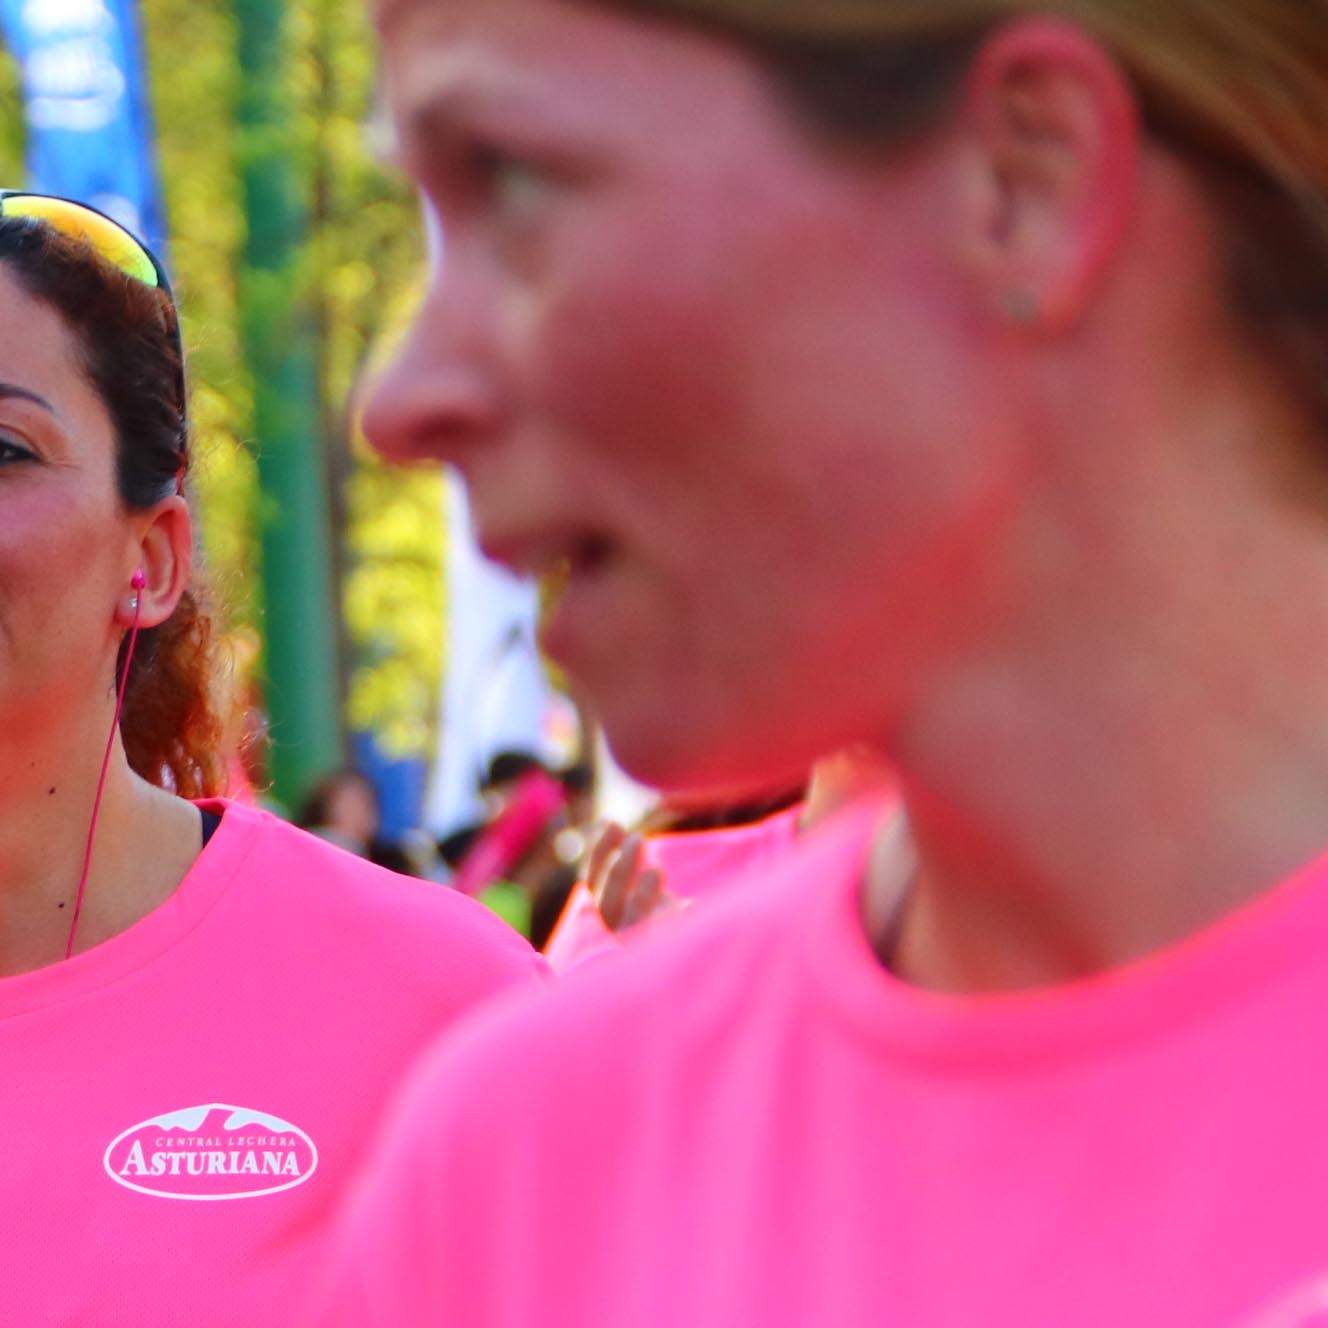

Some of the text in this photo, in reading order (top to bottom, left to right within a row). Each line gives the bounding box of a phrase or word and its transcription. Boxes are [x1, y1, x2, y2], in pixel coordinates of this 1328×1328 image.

[155, 1135, 296, 1148] CENTRAL LECHERA
[118, 1138, 301, 1177] ASTURIANA
